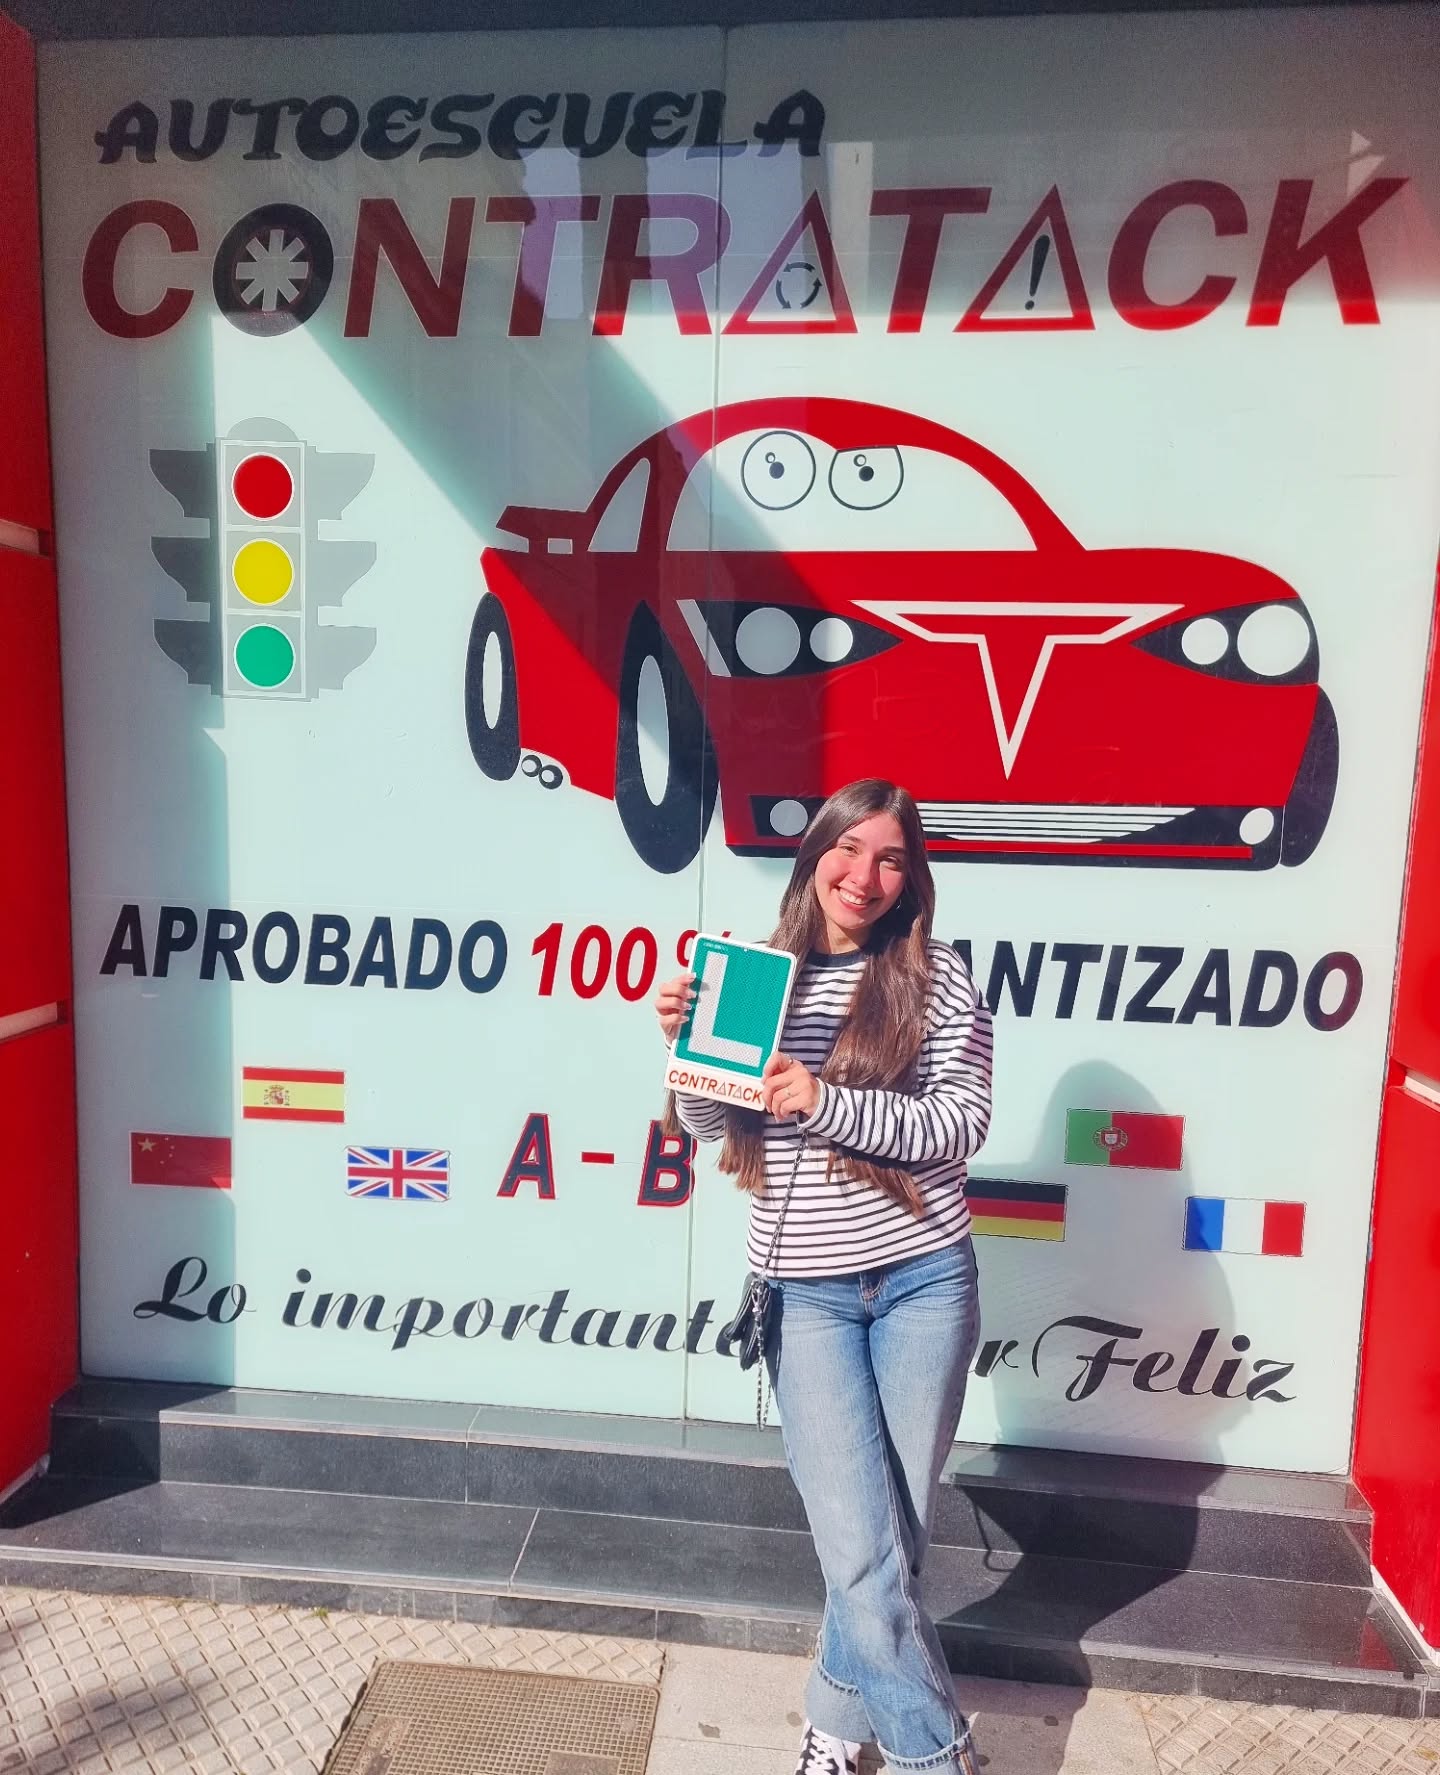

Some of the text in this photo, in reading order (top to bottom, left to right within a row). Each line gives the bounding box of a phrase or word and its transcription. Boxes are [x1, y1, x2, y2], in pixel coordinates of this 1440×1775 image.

[96, 90, 826, 164] AUTOESCUELA
[82, 177, 1410, 338] CONTRATACK
[100, 904, 508, 994] APROBADO
[531, 922, 658, 1001] 100
[951, 939, 1364, 1032] NTIZADO
[687, 951, 763, 1068] L
[496, 1112, 556, 1200] A
[637, 1119, 698, 1207] B
[133, 1256, 257, 1324] Lo
[1032, 1315, 1297, 1402] Feliz
